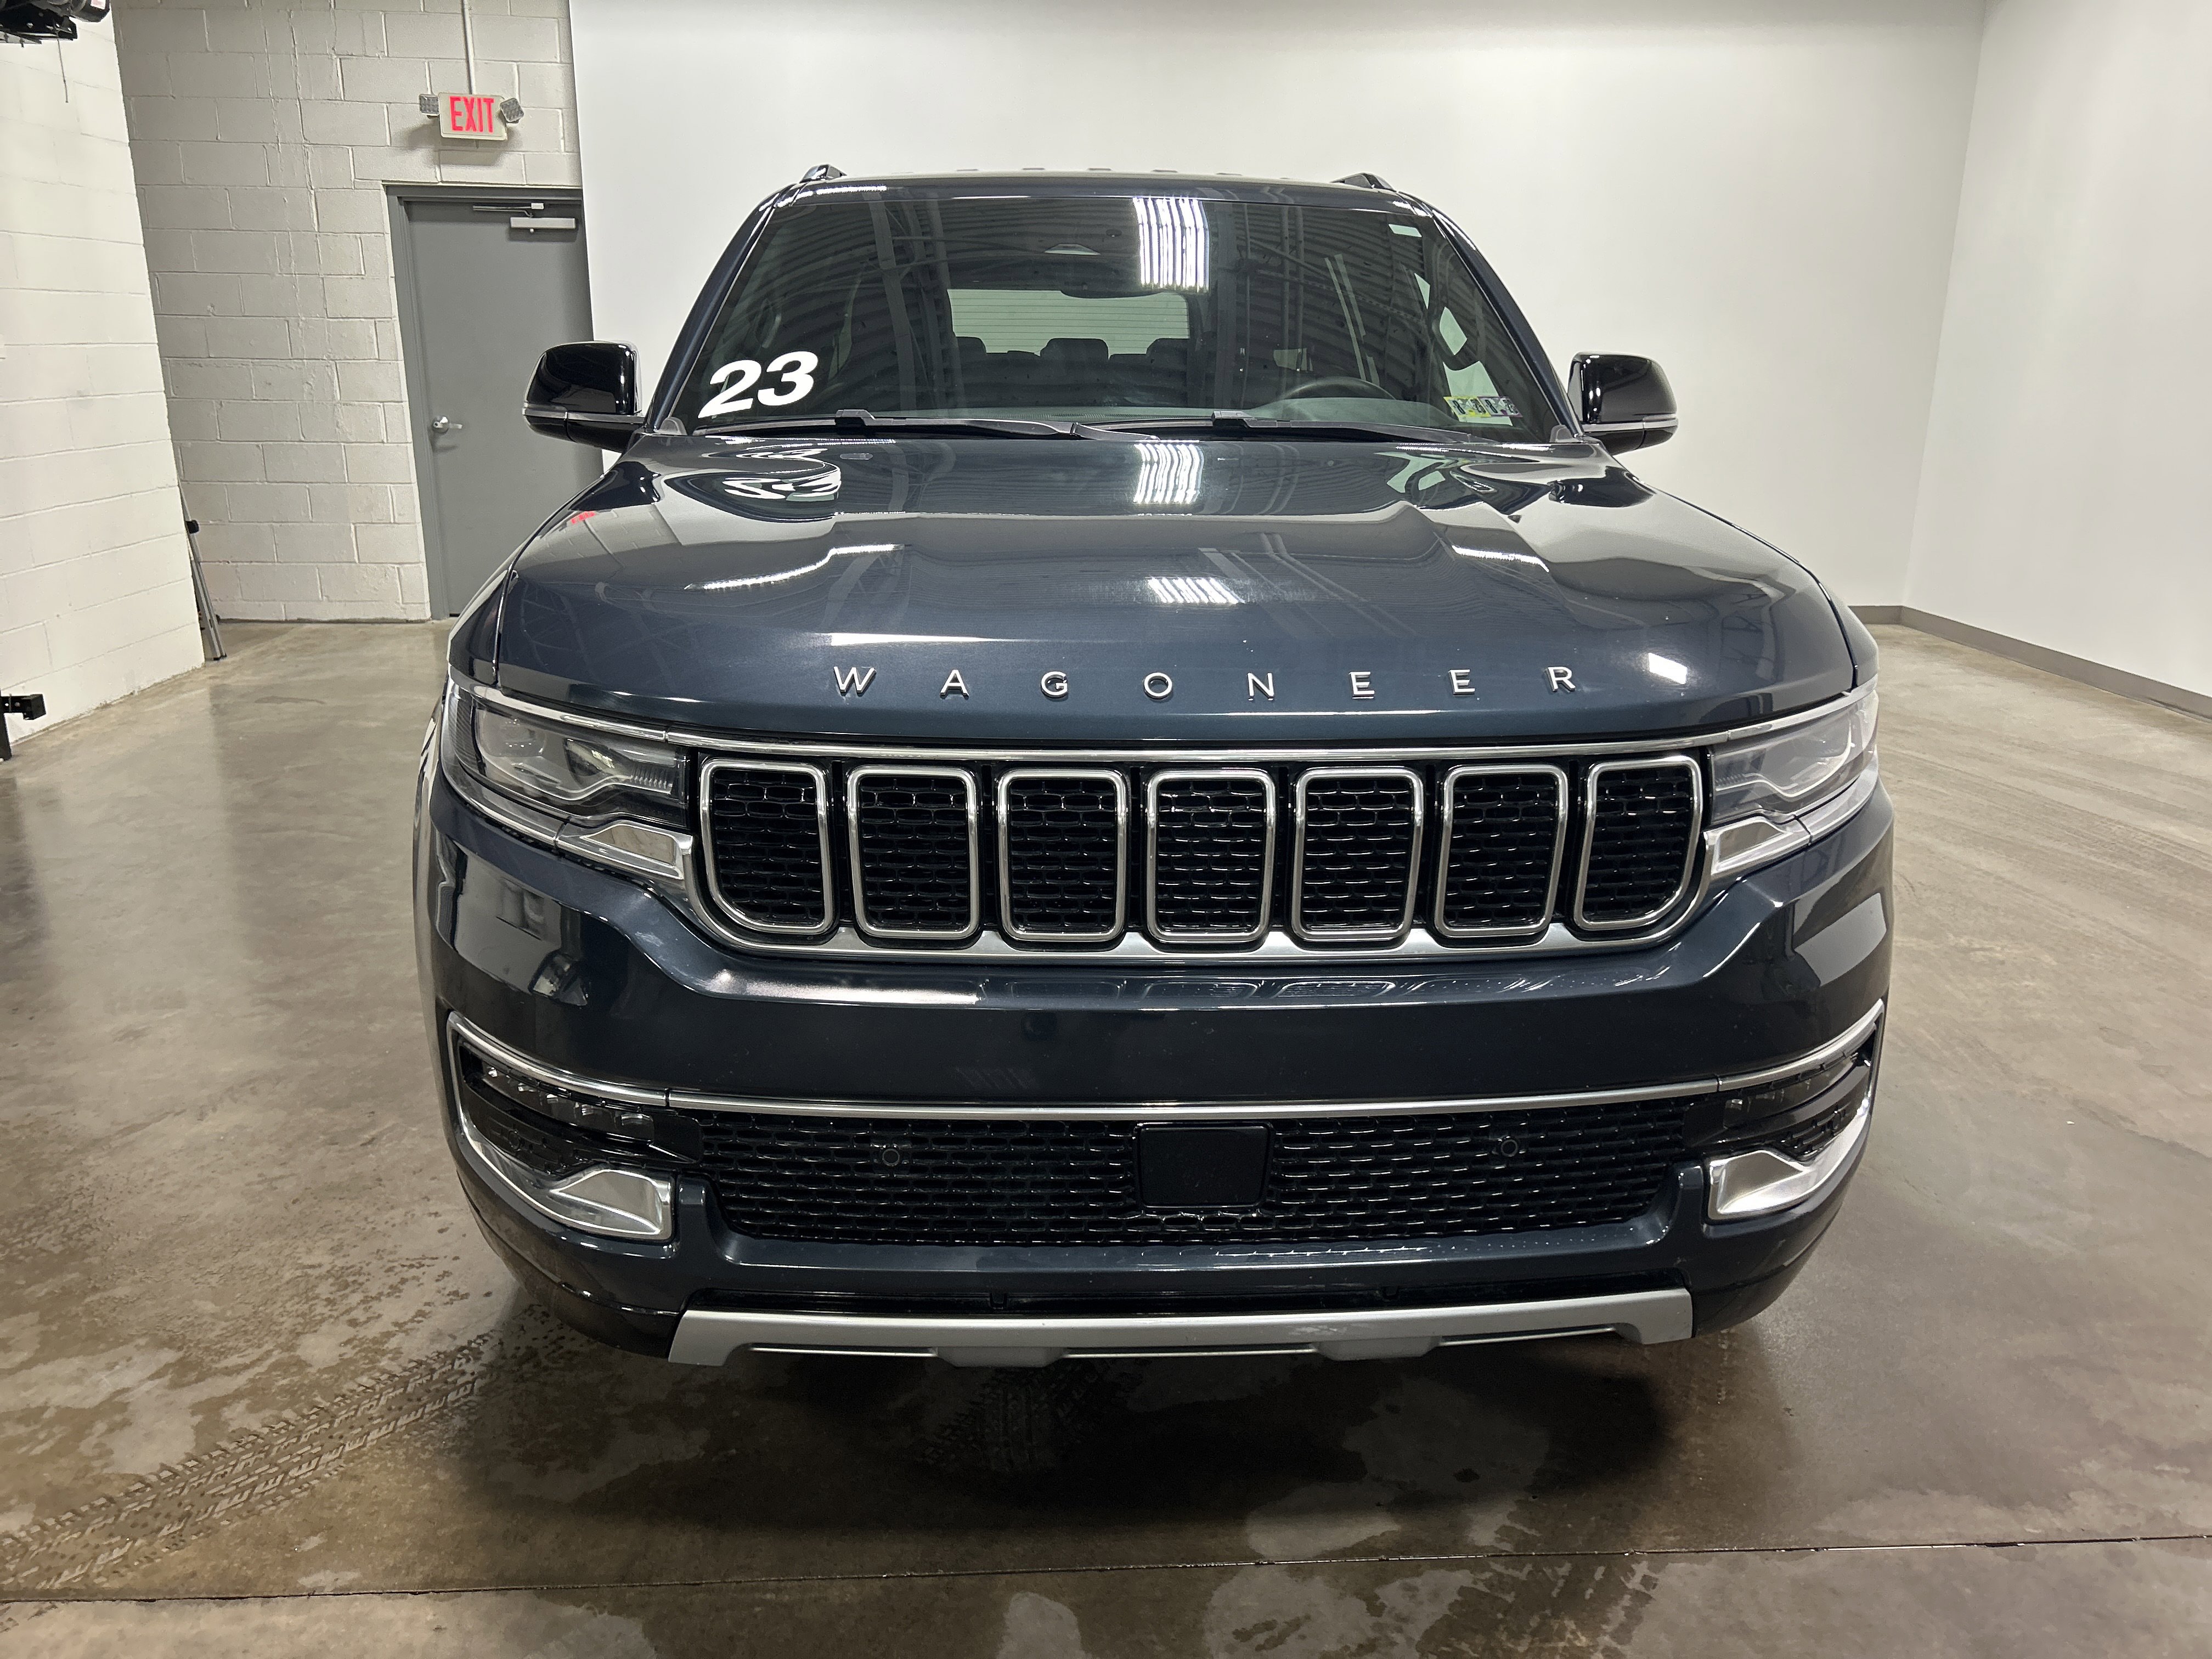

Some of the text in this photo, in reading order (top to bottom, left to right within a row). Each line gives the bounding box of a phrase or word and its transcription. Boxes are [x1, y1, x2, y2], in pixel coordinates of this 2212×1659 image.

[449, 96, 495, 133] EXIT
[698, 351, 818, 418] 23
[833, 665, 1576, 699] WAGONEER
